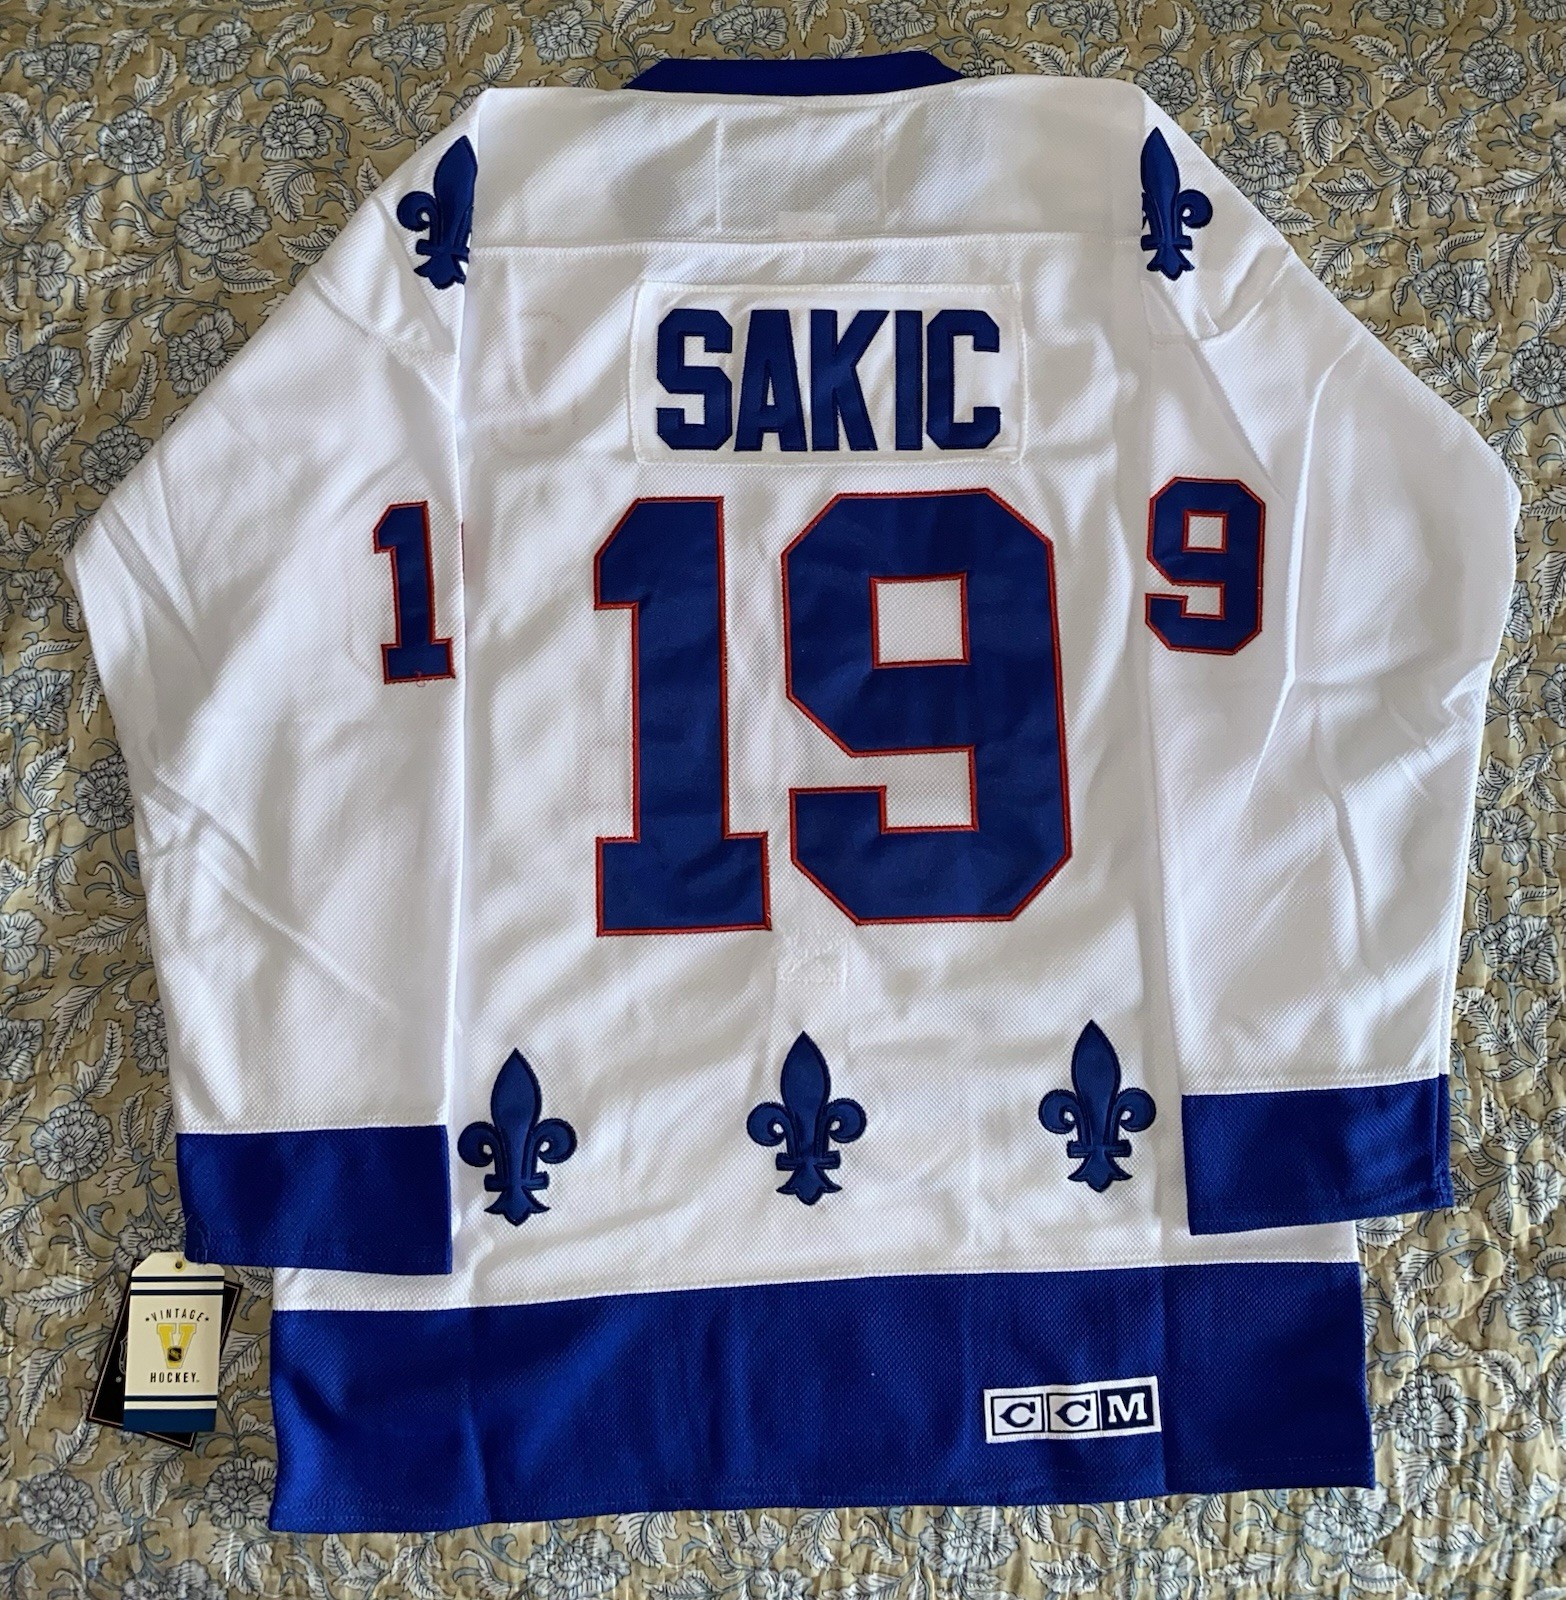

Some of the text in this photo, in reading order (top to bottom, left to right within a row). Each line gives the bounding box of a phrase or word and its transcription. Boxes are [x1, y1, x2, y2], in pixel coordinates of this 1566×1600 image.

[657, 309, 1001, 452] SAKIC
[1145, 476, 1266, 656] 9
[594, 487, 1072, 936] 19
[151, 1308, 204, 1322] VINTAGE
[157, 1323, 197, 1369] V
[150, 1372, 197, 1383] HOCKEY
[999, 1392, 1148, 1428] CCM
